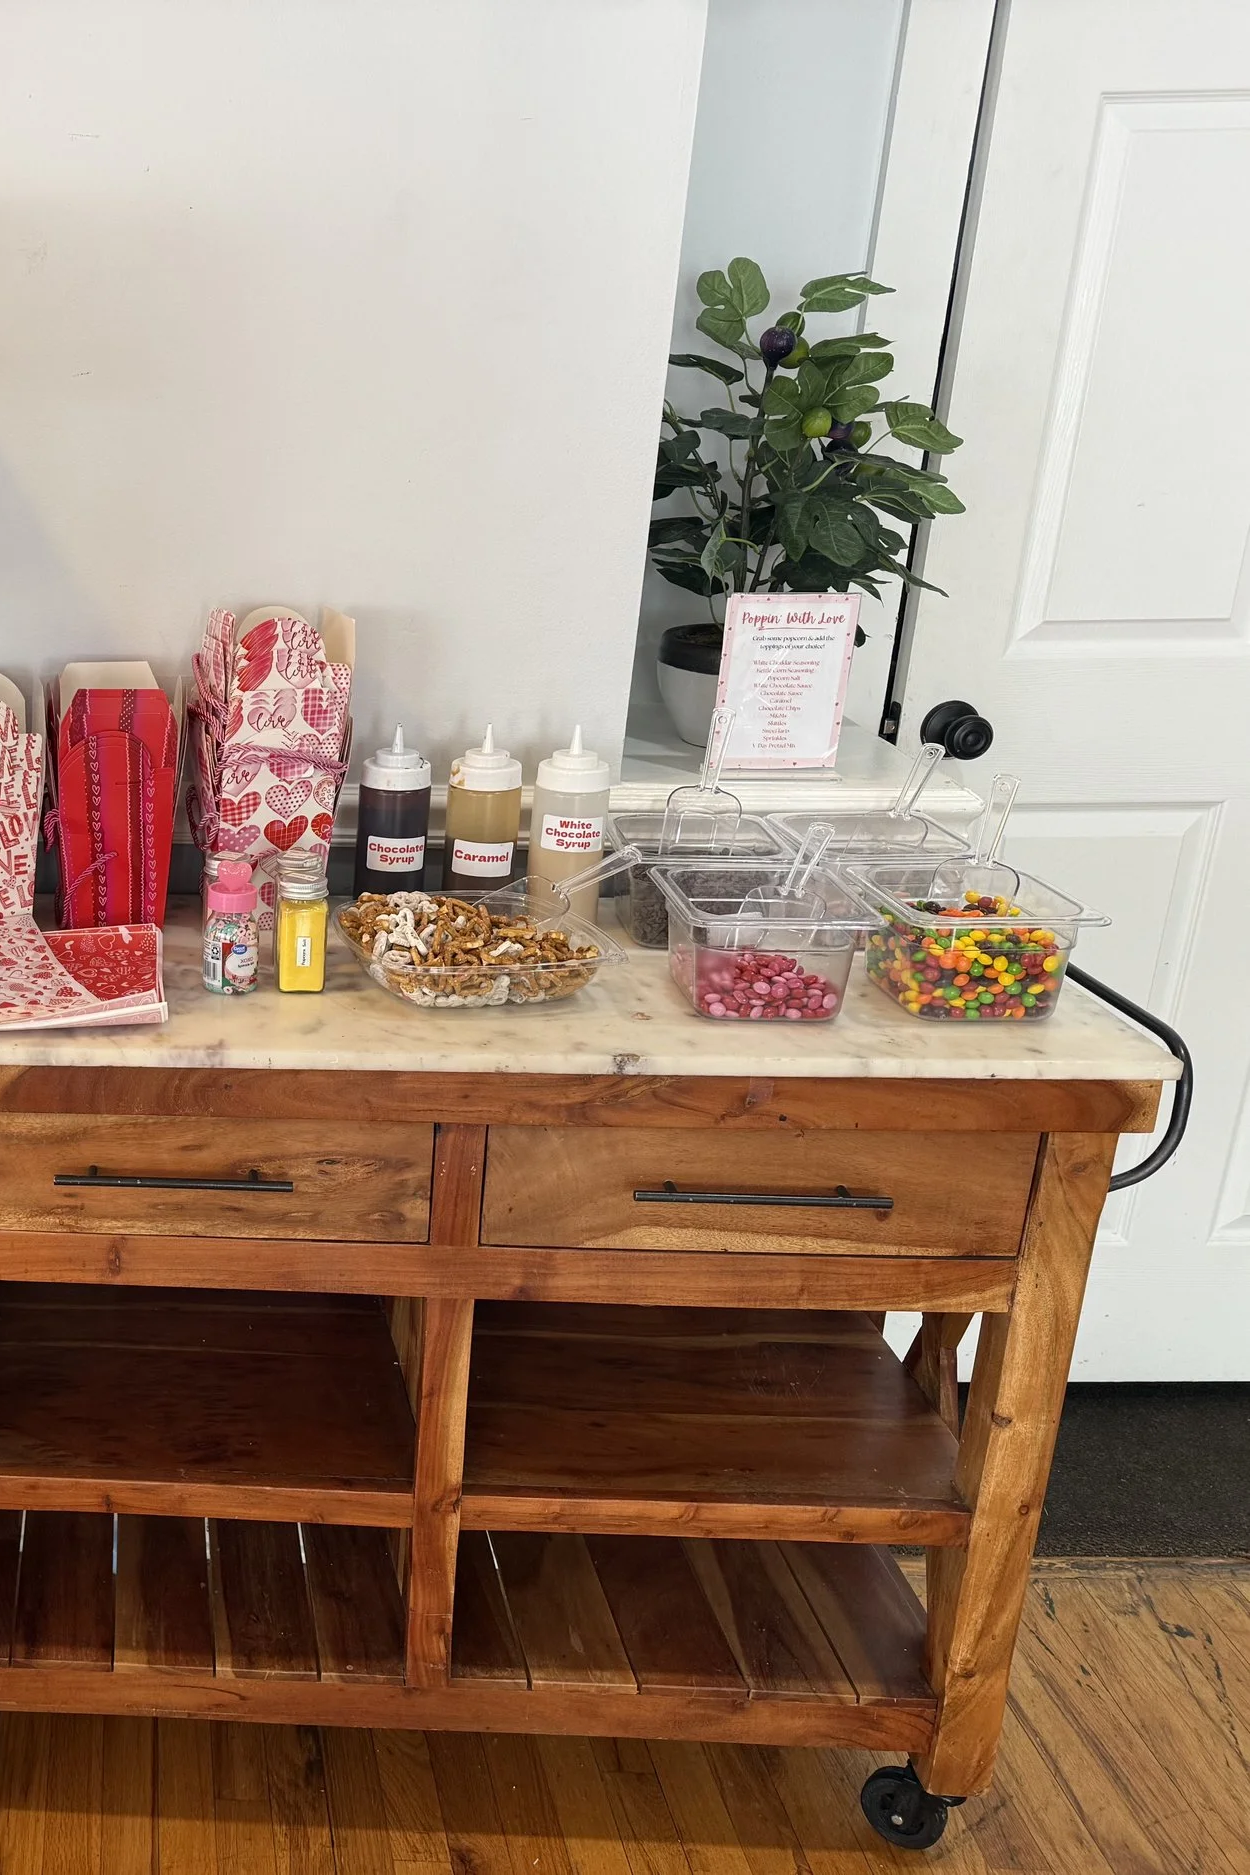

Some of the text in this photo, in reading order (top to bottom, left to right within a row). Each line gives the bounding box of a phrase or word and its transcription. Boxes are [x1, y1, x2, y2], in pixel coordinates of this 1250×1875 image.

[742, 611, 846, 630] Poppin' With Love
[793, 659, 821, 667] Seasoning
[788, 667, 815, 675] Seasoning
[256, 712, 287, 732] love
[558, 819, 593, 830] White
[545, 827, 601, 839] Chocolate
[368, 842, 424, 854] Chocolate
[555, 838, 591, 850] Syrup
[379, 853, 415, 866] Syrup
[453, 849, 510, 863] Caramel
